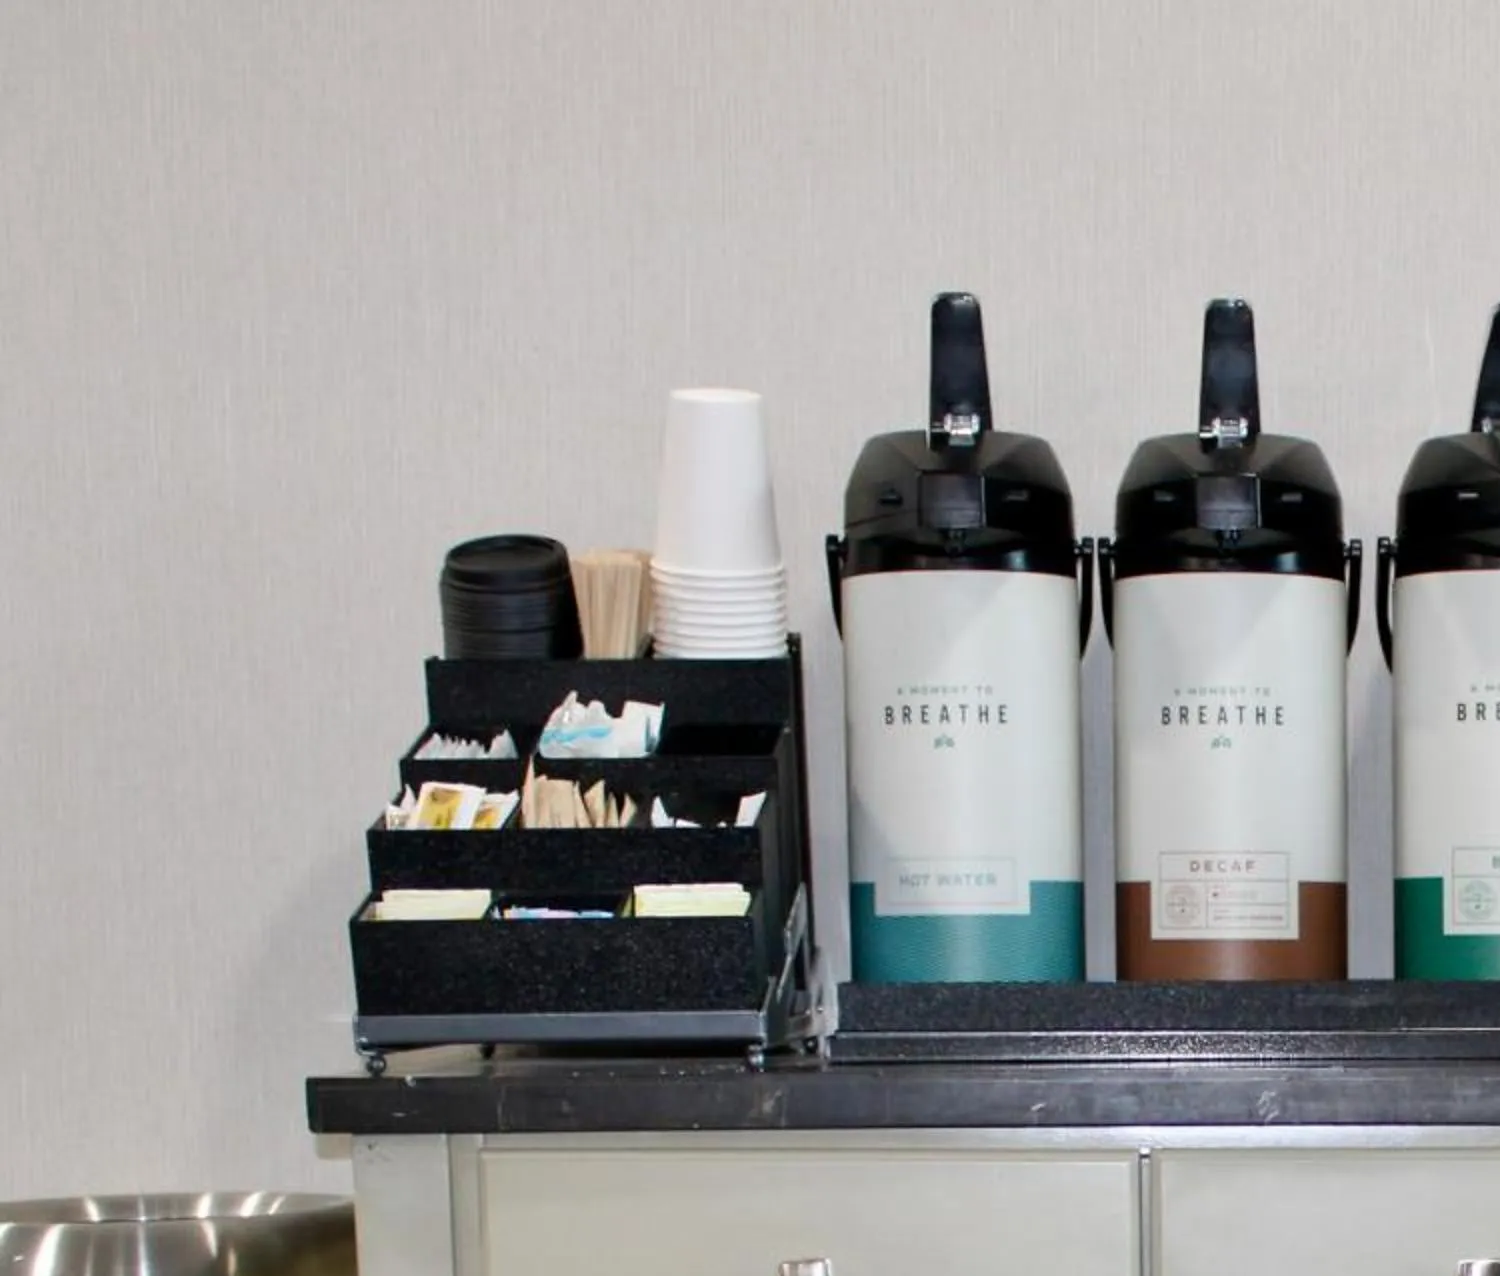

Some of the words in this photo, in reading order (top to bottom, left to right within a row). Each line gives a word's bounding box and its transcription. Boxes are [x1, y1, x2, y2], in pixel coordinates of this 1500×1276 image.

[909, 685, 969, 696] MOMENT
[976, 685, 994, 696] TO
[1187, 686, 1247, 697] MOMENT
[884, 704, 1009, 725] BREATHE
[1161, 705, 1286, 726] BREATHE
[1189, 859, 1256, 874] DECAF
[899, 873, 931, 888] HOT
[936, 873, 998, 888] WATER
